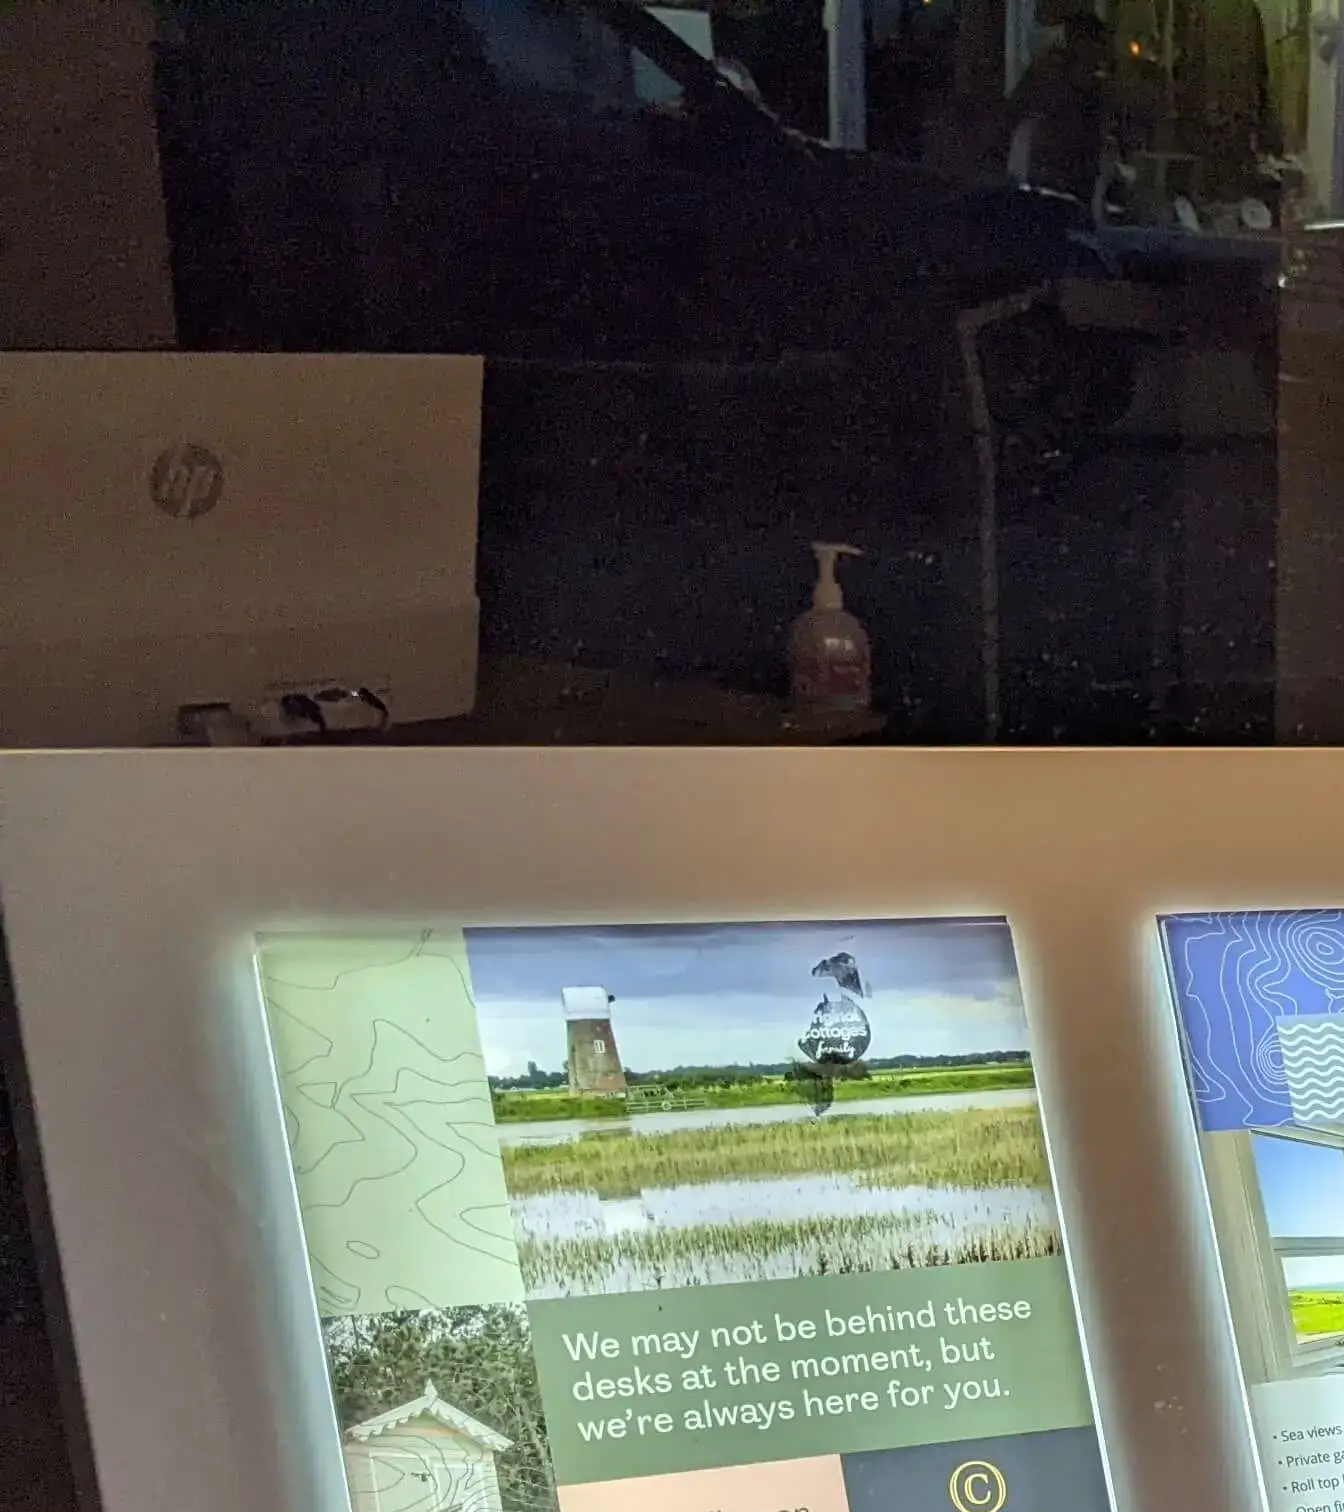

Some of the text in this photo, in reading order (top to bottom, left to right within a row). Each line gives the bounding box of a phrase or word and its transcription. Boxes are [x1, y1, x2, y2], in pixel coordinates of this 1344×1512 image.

[561, 1297, 1031, 1361] We may not be behind these
[572, 1336, 995, 1401] desks at the moment, but
[576, 1378, 1009, 1441] we're always here for you.
[1280, 1424, 1343, 1442] Sea views
[1285, 1452, 1330, 1467] Private
[1290, 1477, 1315, 1493] Roll
[1316, 1477, 1339, 1490] top
